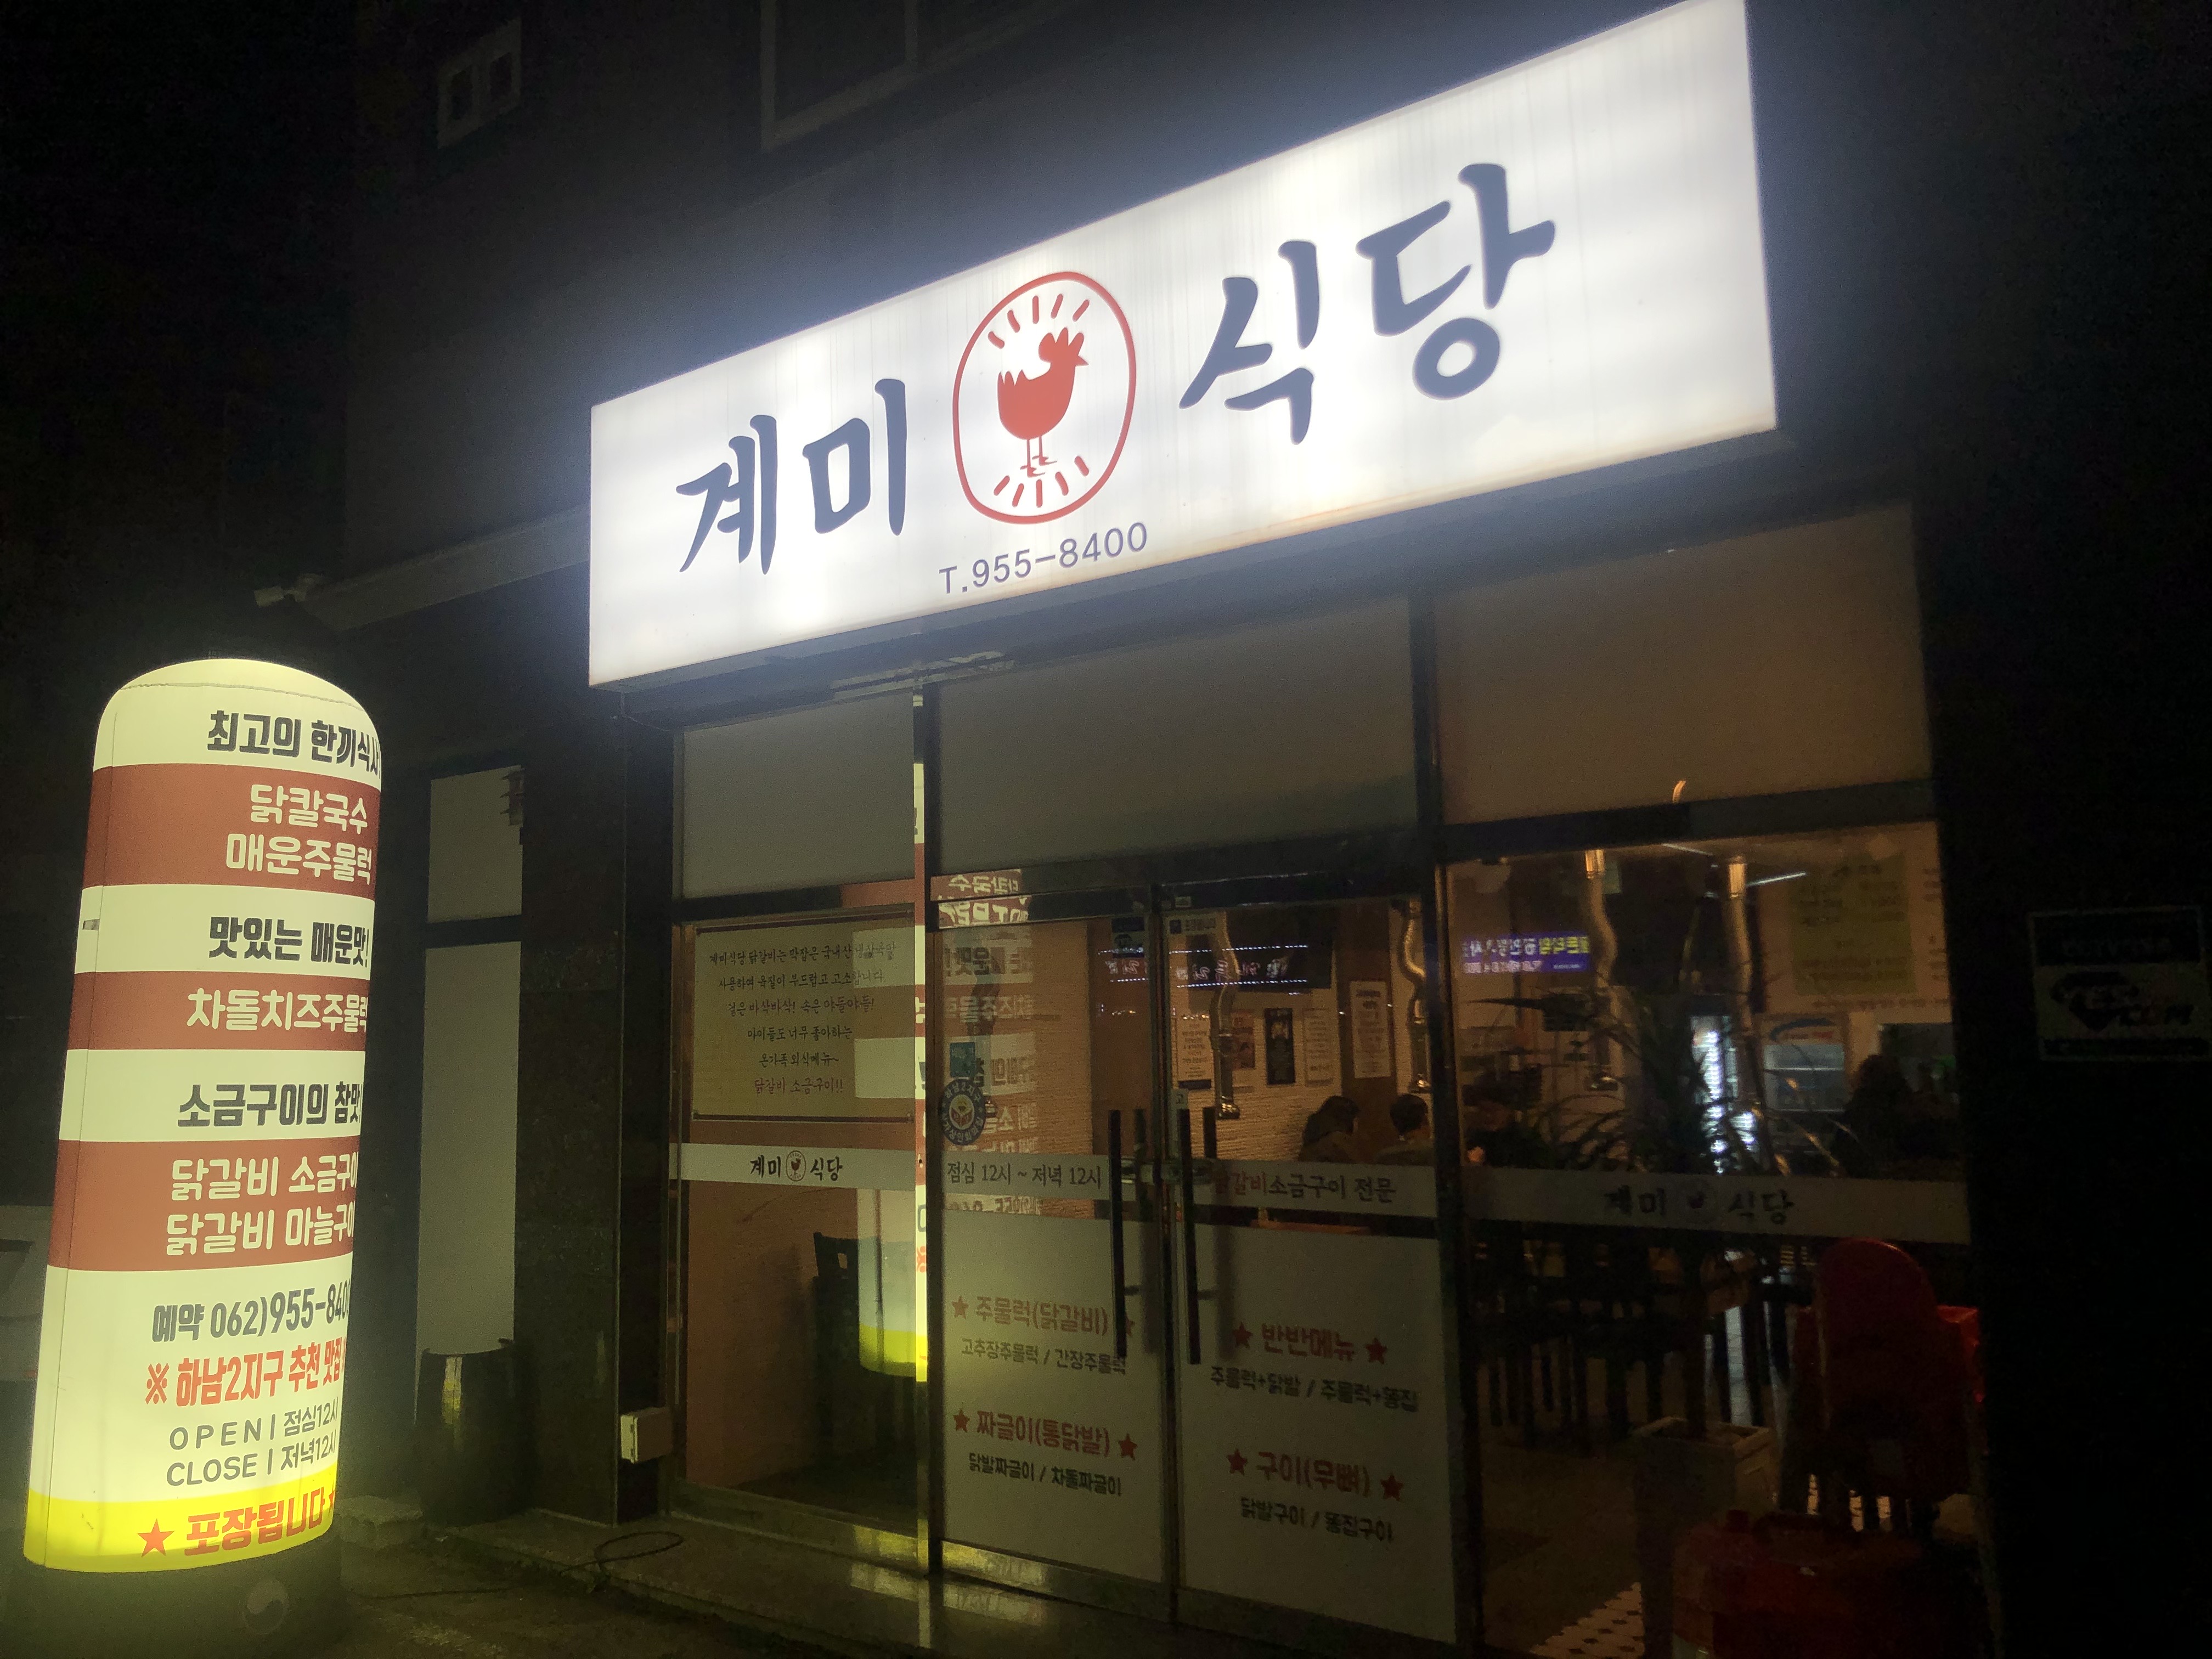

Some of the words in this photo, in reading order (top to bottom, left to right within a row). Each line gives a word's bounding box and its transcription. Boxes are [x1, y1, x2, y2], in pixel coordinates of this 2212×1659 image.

[676, 379, 909, 576] 계미
[1180, 163, 1556, 445] 식당
[940, 521, 1149, 596] T.955-8400
[207, 710, 302, 758] 최고의
[250, 784, 368, 835] 닭칼국수
[225, 833, 373, 885] 매운주물럭
[208, 916, 303, 962] 맛있는
[311, 922, 370, 968] 매운맛!
[748, 948, 787, 964] 닭갈비는
[821, 943, 853, 960] 국내산
[719, 975, 754, 991] 사용하여
[757, 973, 786, 990] 육질이
[788, 972, 829, 988] 부드럽고
[187, 988, 369, 1033] 차돌치즈주물럭
[749, 998, 797, 1014] 바삭바삭!
[800, 998, 821, 1014] 속은
[823, 995, 875, 1014] 야들야들!
[747, 1026, 786, 1042] 아이들도
[788, 1025, 809, 1041] 너무
[810, 1024, 853, 1042] 좋아하는
[177, 1084, 329, 1128] 소금구이의
[754, 1076, 786, 1095] 닭갈비
[789, 1076, 844, 1095] 소금구이!!
[171, 1155, 279, 1201] 닭갈비
[288, 1151, 359, 1193] 소금구이
[749, 1154, 781, 1178] 계미
[810, 1156, 843, 1181] 식당
[947, 1161, 975, 1184] 점심
[981, 1162, 1011, 1185] 12시
[1031, 1164, 1062, 1188] 저녁
[1069, 1165, 1101, 1189] 12시
[1354, 1175, 1397, 1204] 전문
[1603, 1184, 1666, 1217] 계미
[1727, 1188, 1796, 1226] 식당
[166, 1209, 275, 1256] 닭갈비
[285, 1200, 356, 1247] 마늘구이
[151, 1302, 205, 1343] 예약
[975, 1295, 1109, 1336] 주물럭(닭갈비)
[961, 1338, 1039, 1364] 고추장주물럭
[1054, 1348, 1126, 1375] 간장주물럭
[1261, 1323, 1355, 1362] 반반메뉴
[176, 1349, 284, 1408] 하남2지구
[289, 1342, 321, 1393] 추천
[323, 1336, 342, 1386] 맛집
[169, 1417, 262, 1451] OPEN
[283, 1396, 339, 1437] 점심12시
[976, 1409, 1110, 1458] 짜글이(통닭발)
[166, 1452, 257, 1487] CLOSE
[280, 1427, 337, 1471] 저녁12시
[968, 1452, 1035, 1482] 닭발짜글이
[1051, 1465, 1122, 1497] 차돌짜글이
[1256, 1451, 1370, 1498] 구이(무뼈)
[185, 1485, 325, 1556] 포장됩니다
[1240, 1496, 1306, 1525] 닭발구이
